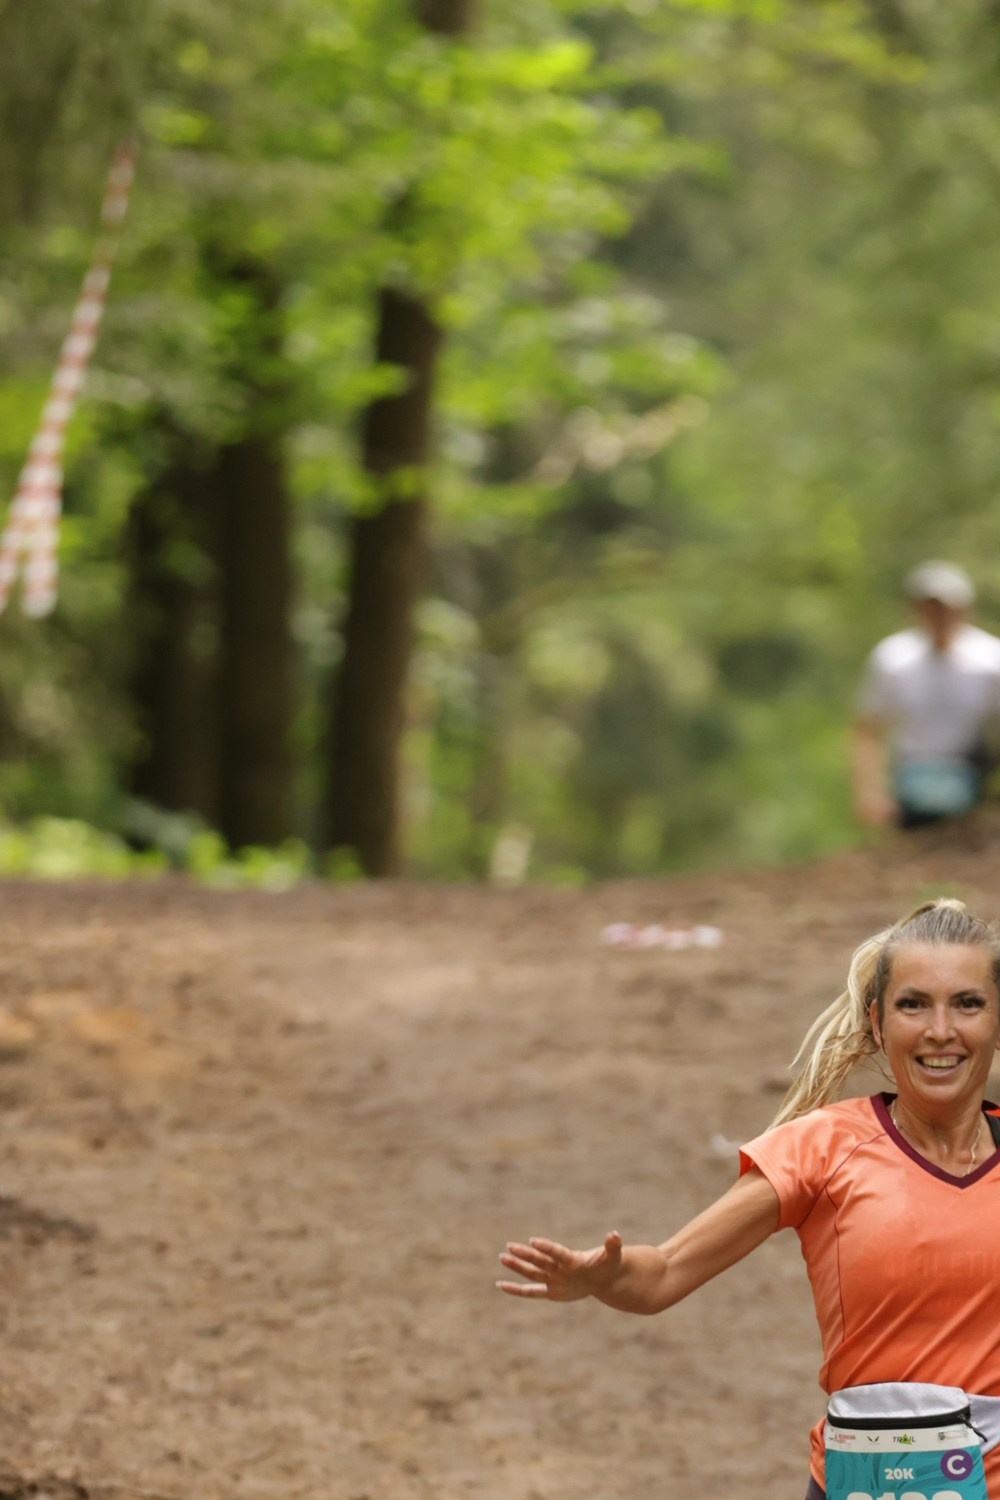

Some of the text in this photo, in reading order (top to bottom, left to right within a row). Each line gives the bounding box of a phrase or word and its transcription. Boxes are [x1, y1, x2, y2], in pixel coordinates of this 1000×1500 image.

[892, 1434, 916, 1444] TRAIL
[946, 1454, 967, 1476] C
[884, 1467, 915, 1480] 20K
